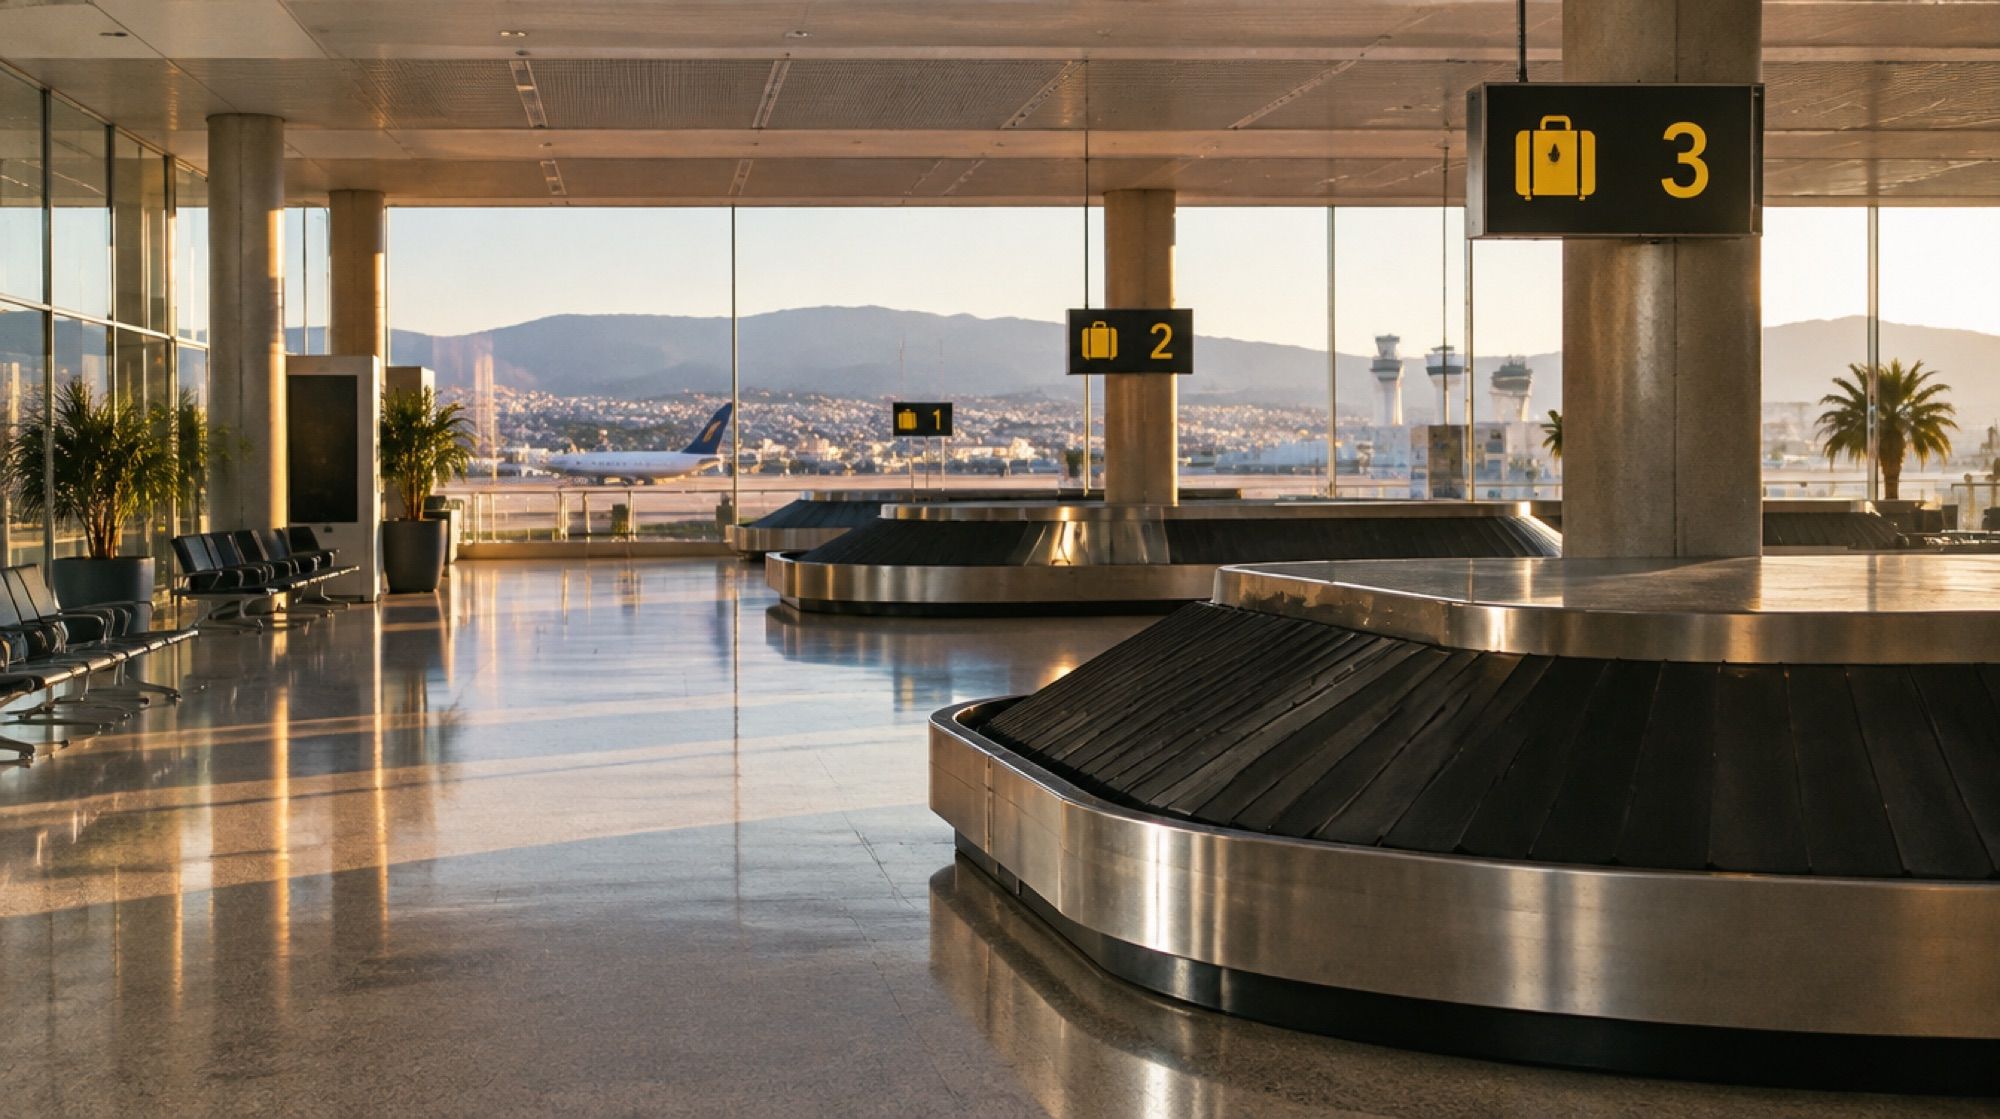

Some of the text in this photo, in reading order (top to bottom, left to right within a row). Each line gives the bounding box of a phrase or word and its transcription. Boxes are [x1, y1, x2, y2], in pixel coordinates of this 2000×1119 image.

[1661, 121, 1709, 199] 3
[1150, 322, 1173, 360] 2
[933, 408, 942, 431] 1
